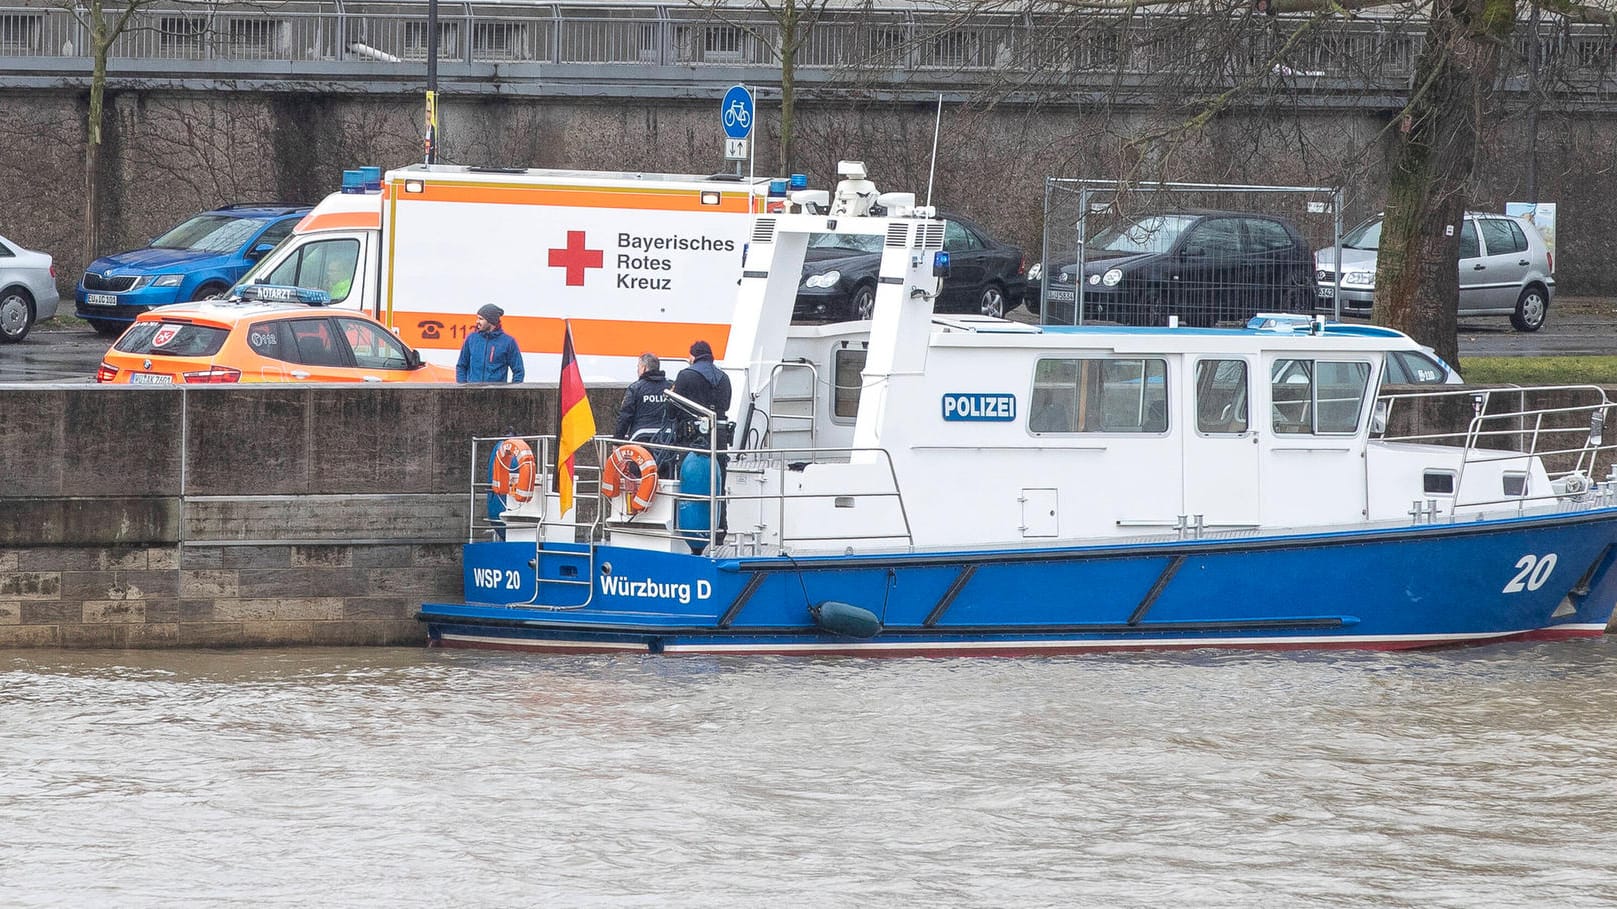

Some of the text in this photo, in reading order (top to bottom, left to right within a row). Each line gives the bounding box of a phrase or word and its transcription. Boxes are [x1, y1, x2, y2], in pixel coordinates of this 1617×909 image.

[617, 232, 735, 253] Bayerisches
[617, 254, 672, 271] Rotes
[616, 273, 672, 290] Kreuz
[257, 287, 291, 299] NOTARZT
[944, 396, 1015, 417] POLIZEI
[473, 567, 521, 590] WSP 20
[1502, 553, 1558, 594] 20
[600, 575, 712, 604] Würzburg D
